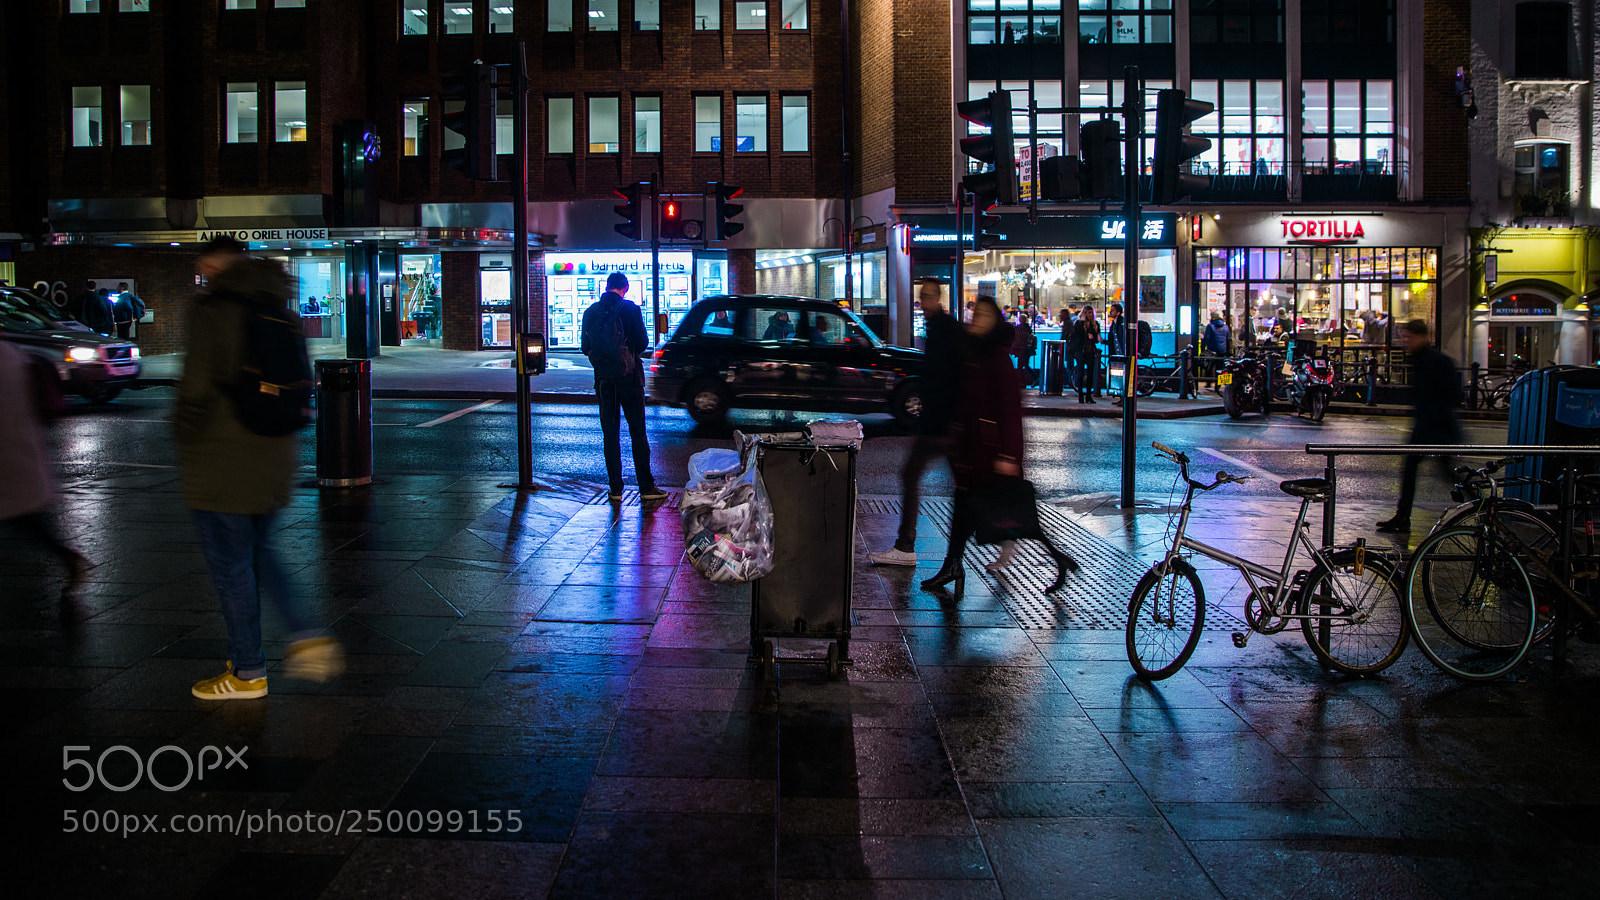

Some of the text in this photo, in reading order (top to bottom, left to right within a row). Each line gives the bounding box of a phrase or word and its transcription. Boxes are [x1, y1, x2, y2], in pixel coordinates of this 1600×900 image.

[1020, 148, 1029, 160] TO
[252, 230, 282, 240] ORIEL
[287, 229, 325, 239] HOUSE
[1142, 219, 1165, 240] 活
[1281, 220, 1364, 237] TORTILLA
[591, 259, 685, 271] barnard mrcus
[33, 280, 69, 308] 26
